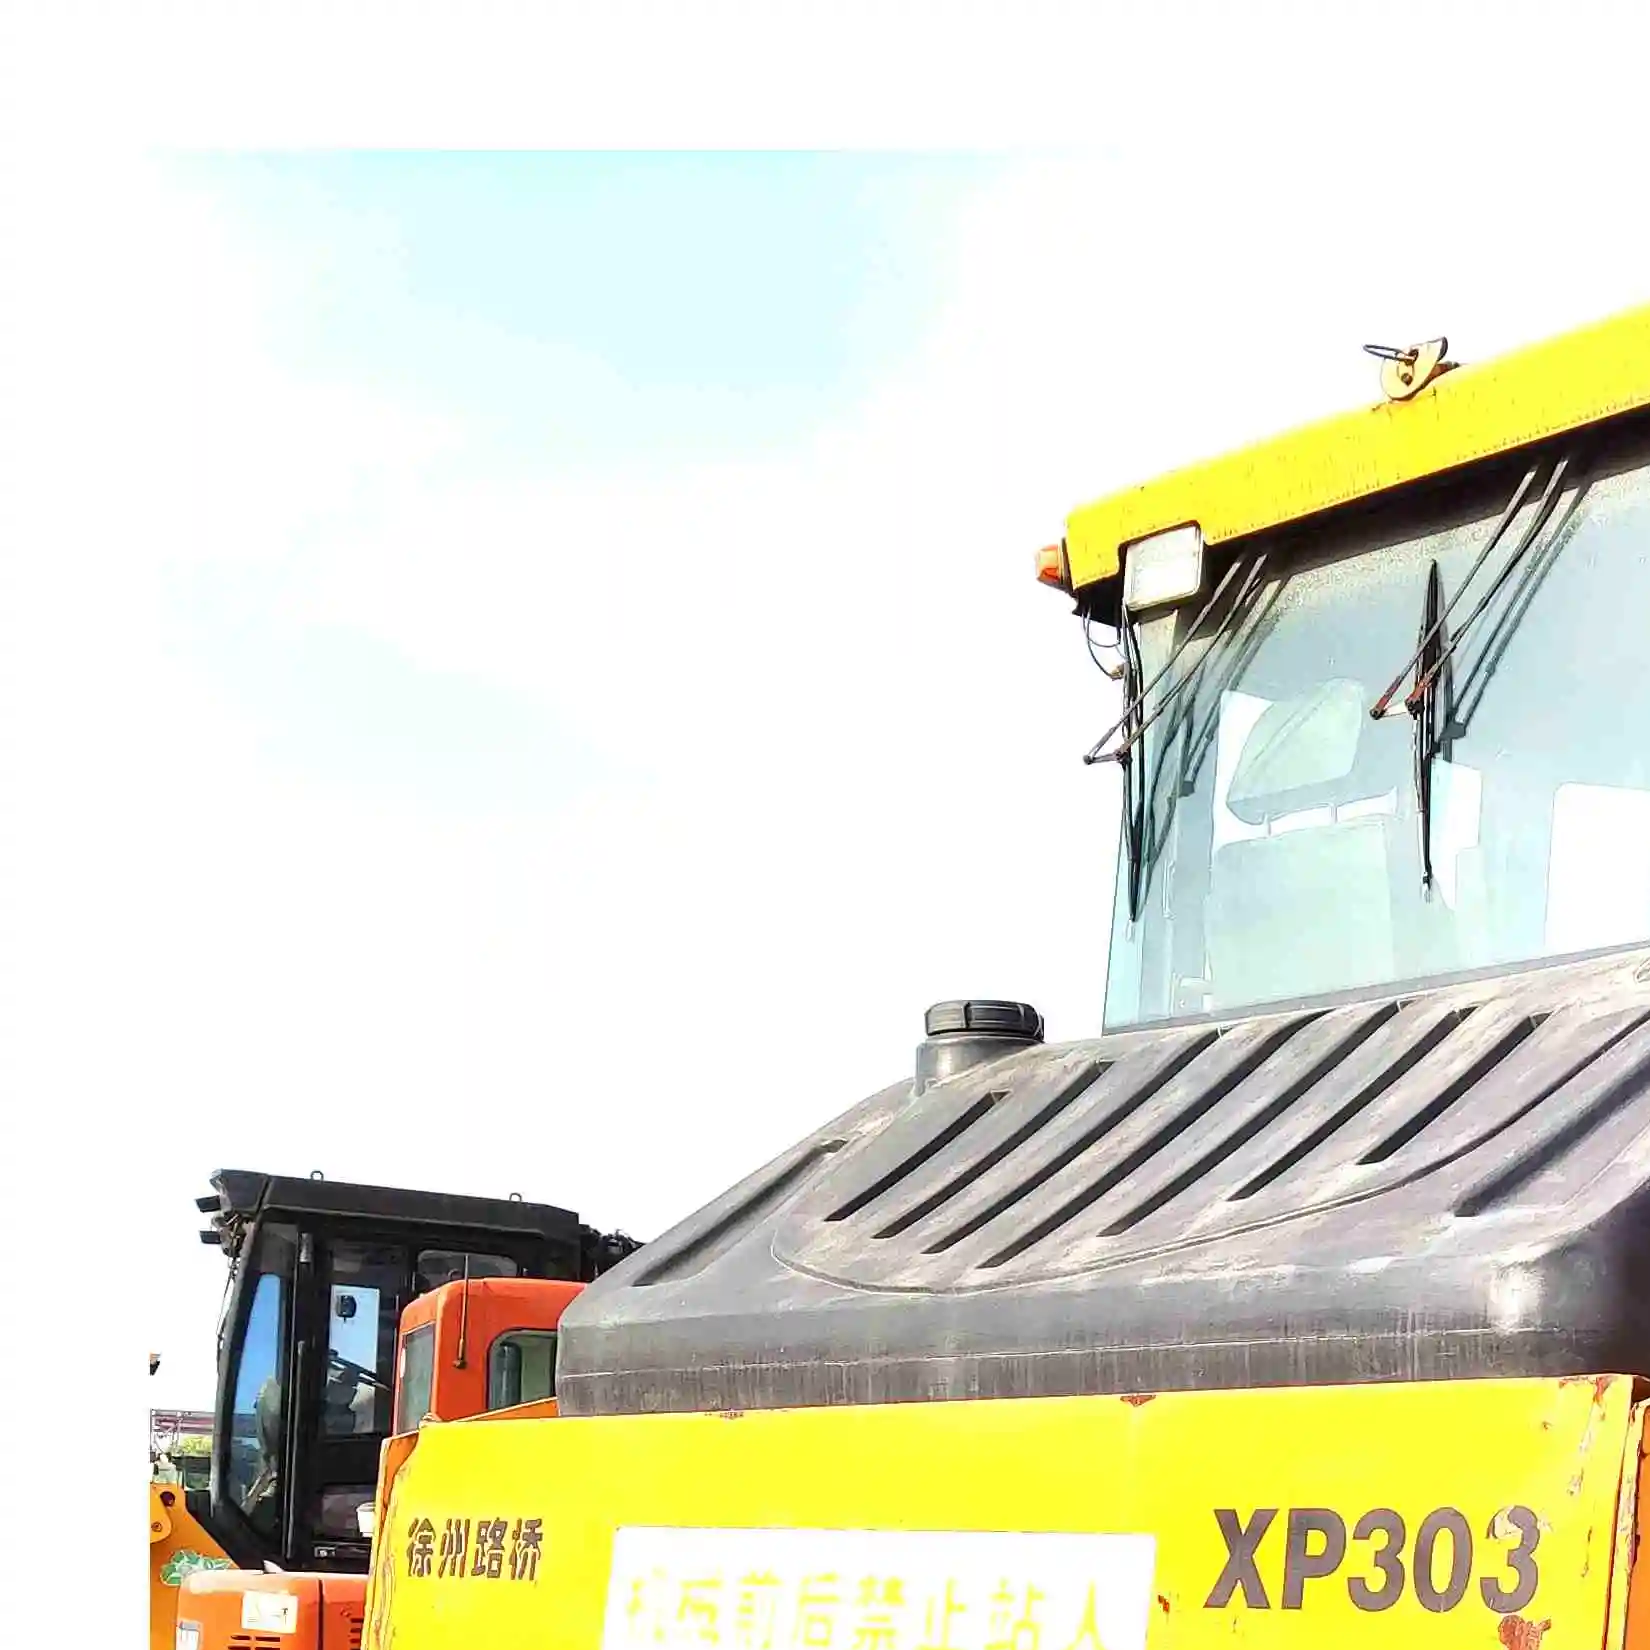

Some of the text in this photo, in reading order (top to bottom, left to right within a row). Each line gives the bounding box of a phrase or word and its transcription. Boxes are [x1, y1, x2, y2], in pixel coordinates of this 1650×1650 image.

[406, 1517, 544, 1581] 徐州路桥
[1203, 1505, 1541, 1613] XP303
